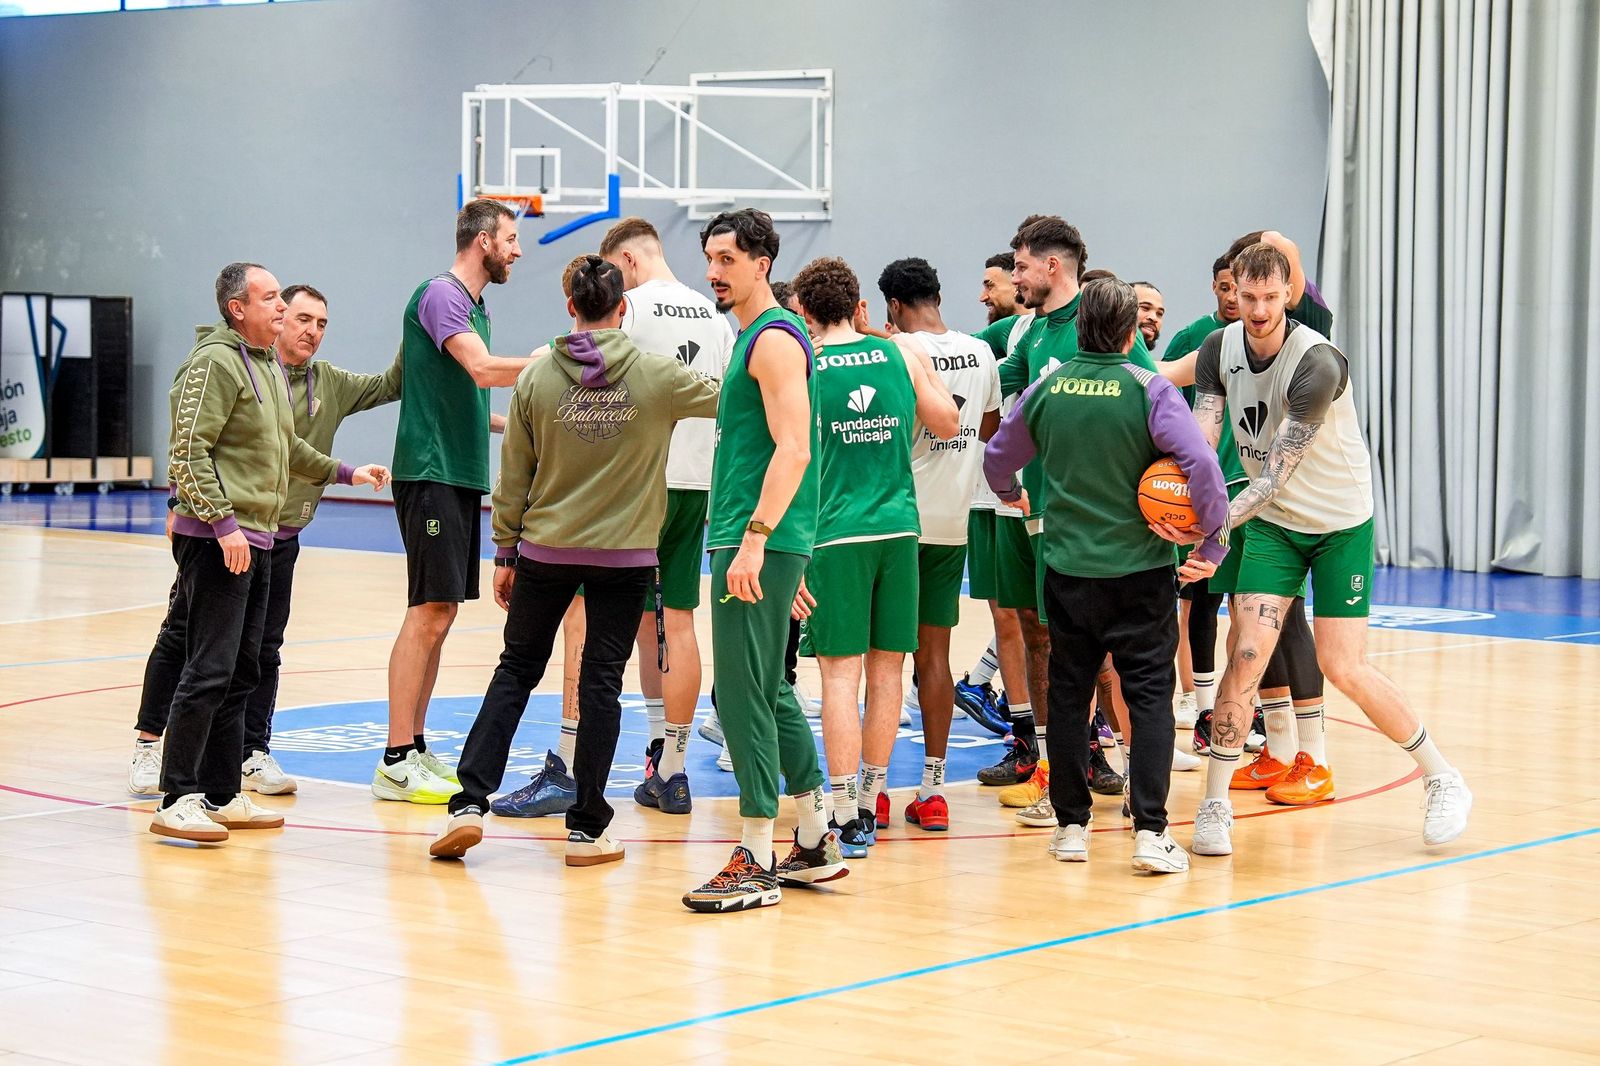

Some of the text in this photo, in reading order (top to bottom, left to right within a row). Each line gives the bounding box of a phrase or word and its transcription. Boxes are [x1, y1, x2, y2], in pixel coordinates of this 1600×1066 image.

[653, 303, 712, 319] Joma
[816, 349, 888, 371] Joma
[569, 384, 628, 409] Unicaja
[1050, 376, 1122, 397] Joma
[553, 402, 638, 423] Baloncesto
[831, 414, 899, 434] Fundación
[842, 428, 892, 444] Unicaja
[1152, 479, 1190, 498] ilson
